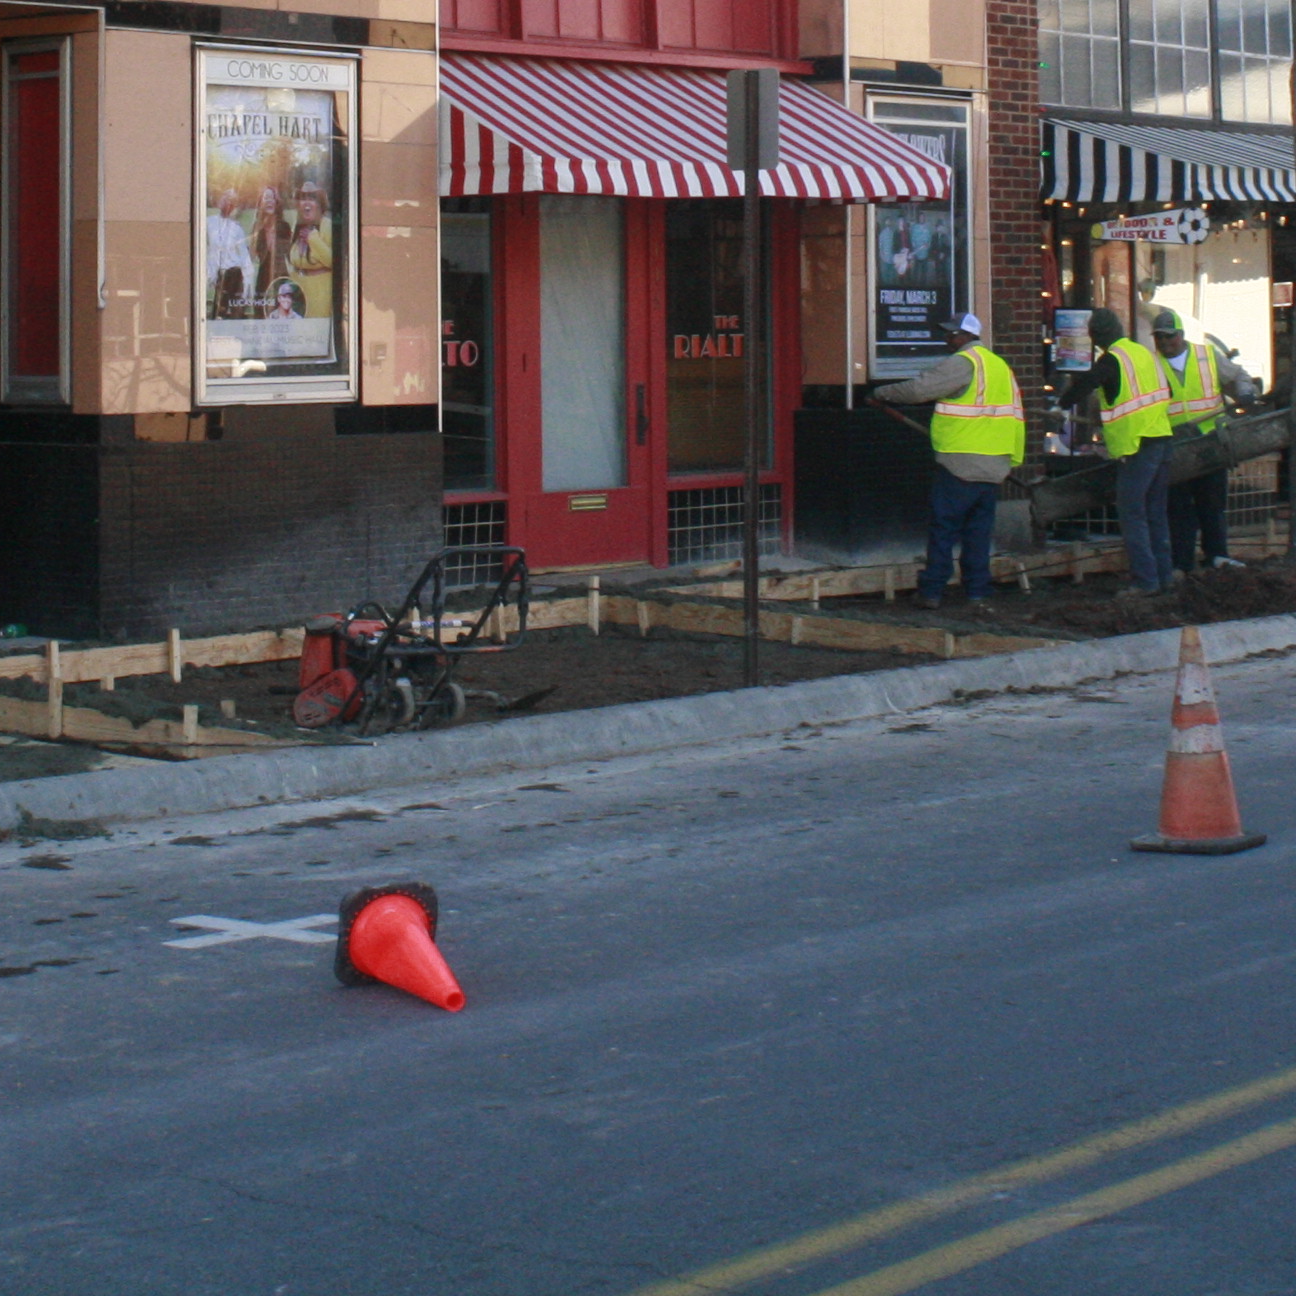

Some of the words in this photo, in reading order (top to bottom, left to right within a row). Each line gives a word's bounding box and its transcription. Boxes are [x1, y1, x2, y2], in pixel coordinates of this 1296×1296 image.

[227, 60, 283, 80] COMING
[289, 64, 328, 82] SOON
[207, 113, 272, 140] CHAPEL
[278, 115, 321, 144] HART
[1111, 229, 1167, 240] LIFESTYLE
[713, 314, 739, 329] THE
[673, 333, 744, 358] RIALT
